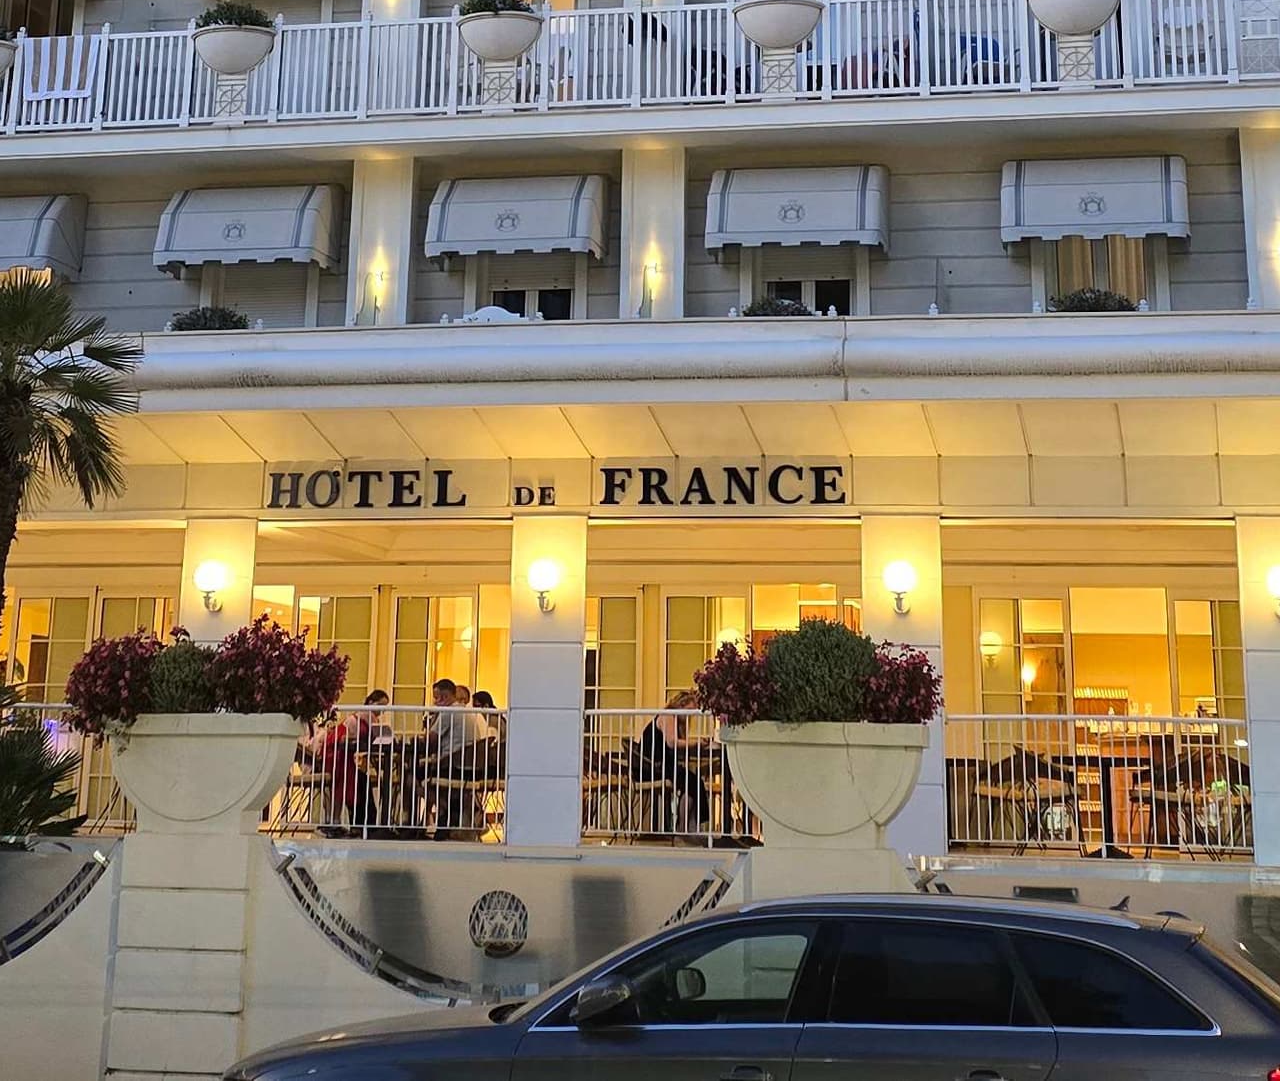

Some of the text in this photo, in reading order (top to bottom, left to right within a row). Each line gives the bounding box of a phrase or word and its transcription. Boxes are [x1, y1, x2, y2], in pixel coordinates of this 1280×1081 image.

[267, 465, 847, 508] HOTEL DE FRANCE
